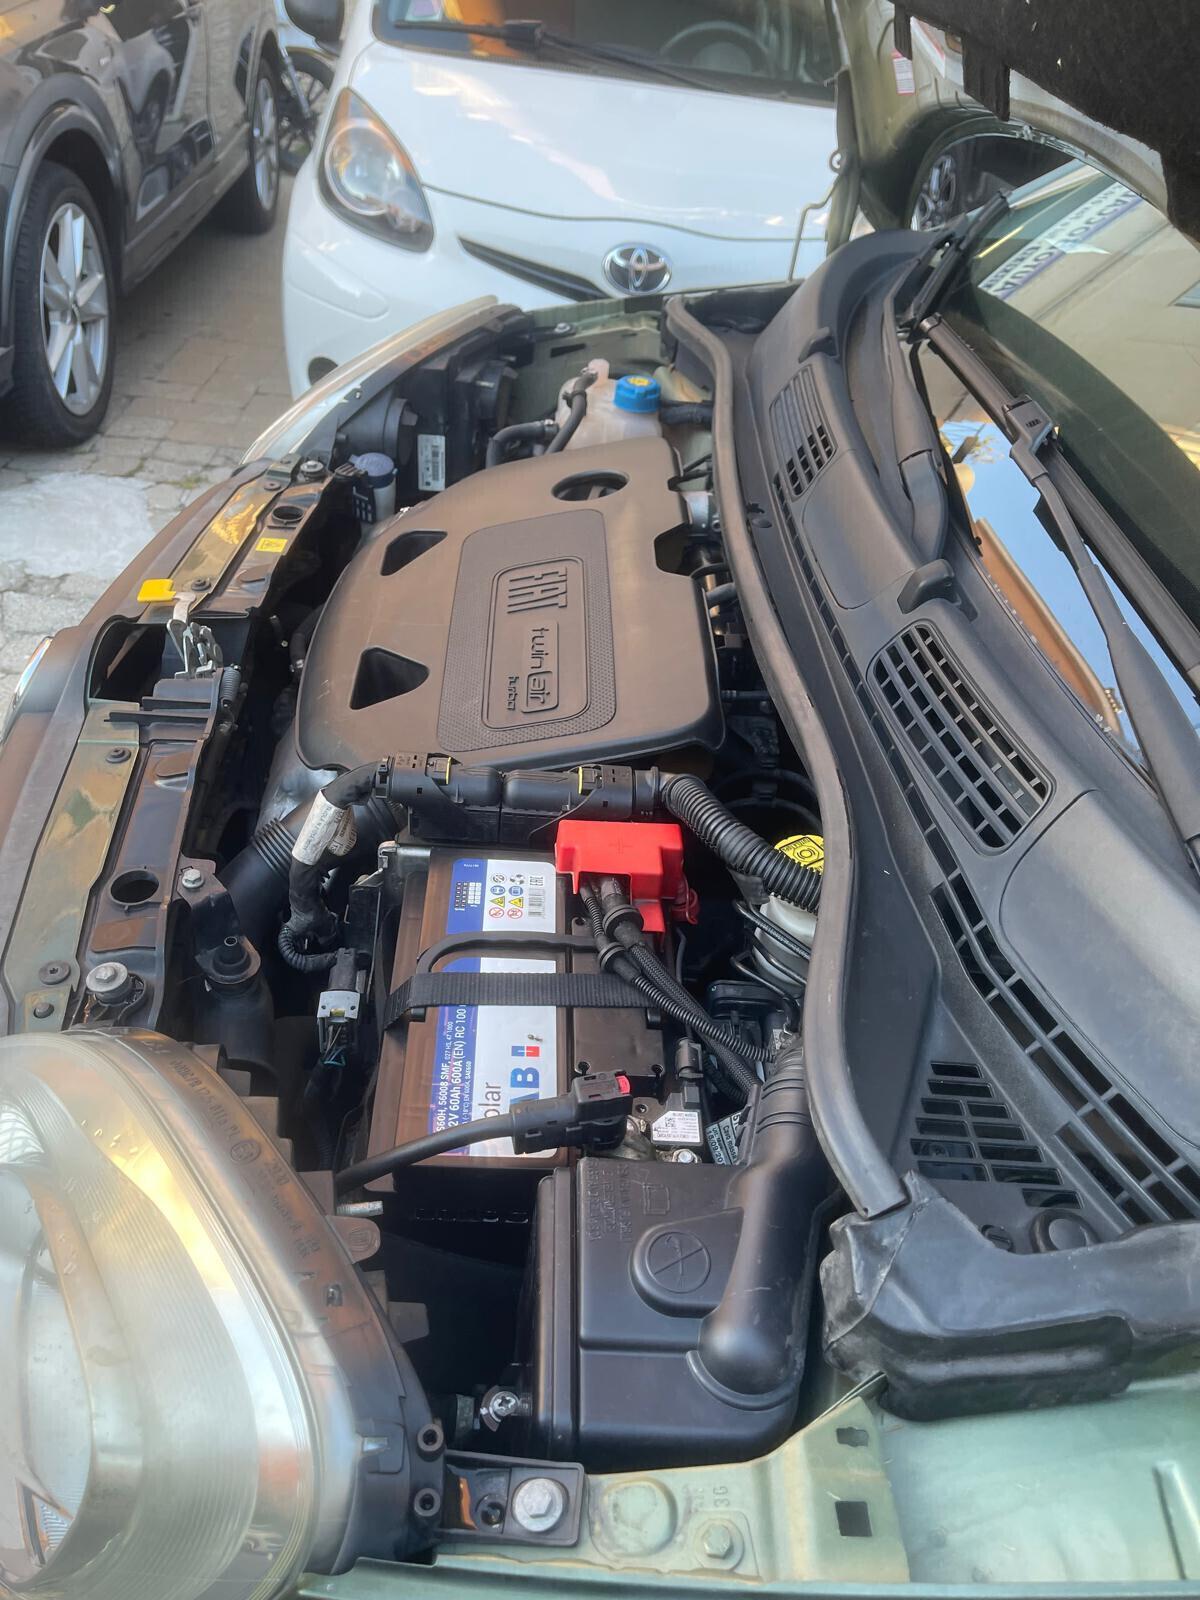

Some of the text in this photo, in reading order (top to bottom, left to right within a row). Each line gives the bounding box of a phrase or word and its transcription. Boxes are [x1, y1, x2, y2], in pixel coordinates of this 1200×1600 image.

[507, 567, 569, 615] FIAT
[456, 1008, 467, 1024] 100
[454, 1025, 465, 1038] RC
[453, 1040, 466, 1059] (EN)
[451, 1060, 464, 1084] 600A
[438, 1081, 449, 1106] 56008
[449, 1086, 461, 1111] 60Ah
[479, 1083, 502, 1118] olar
